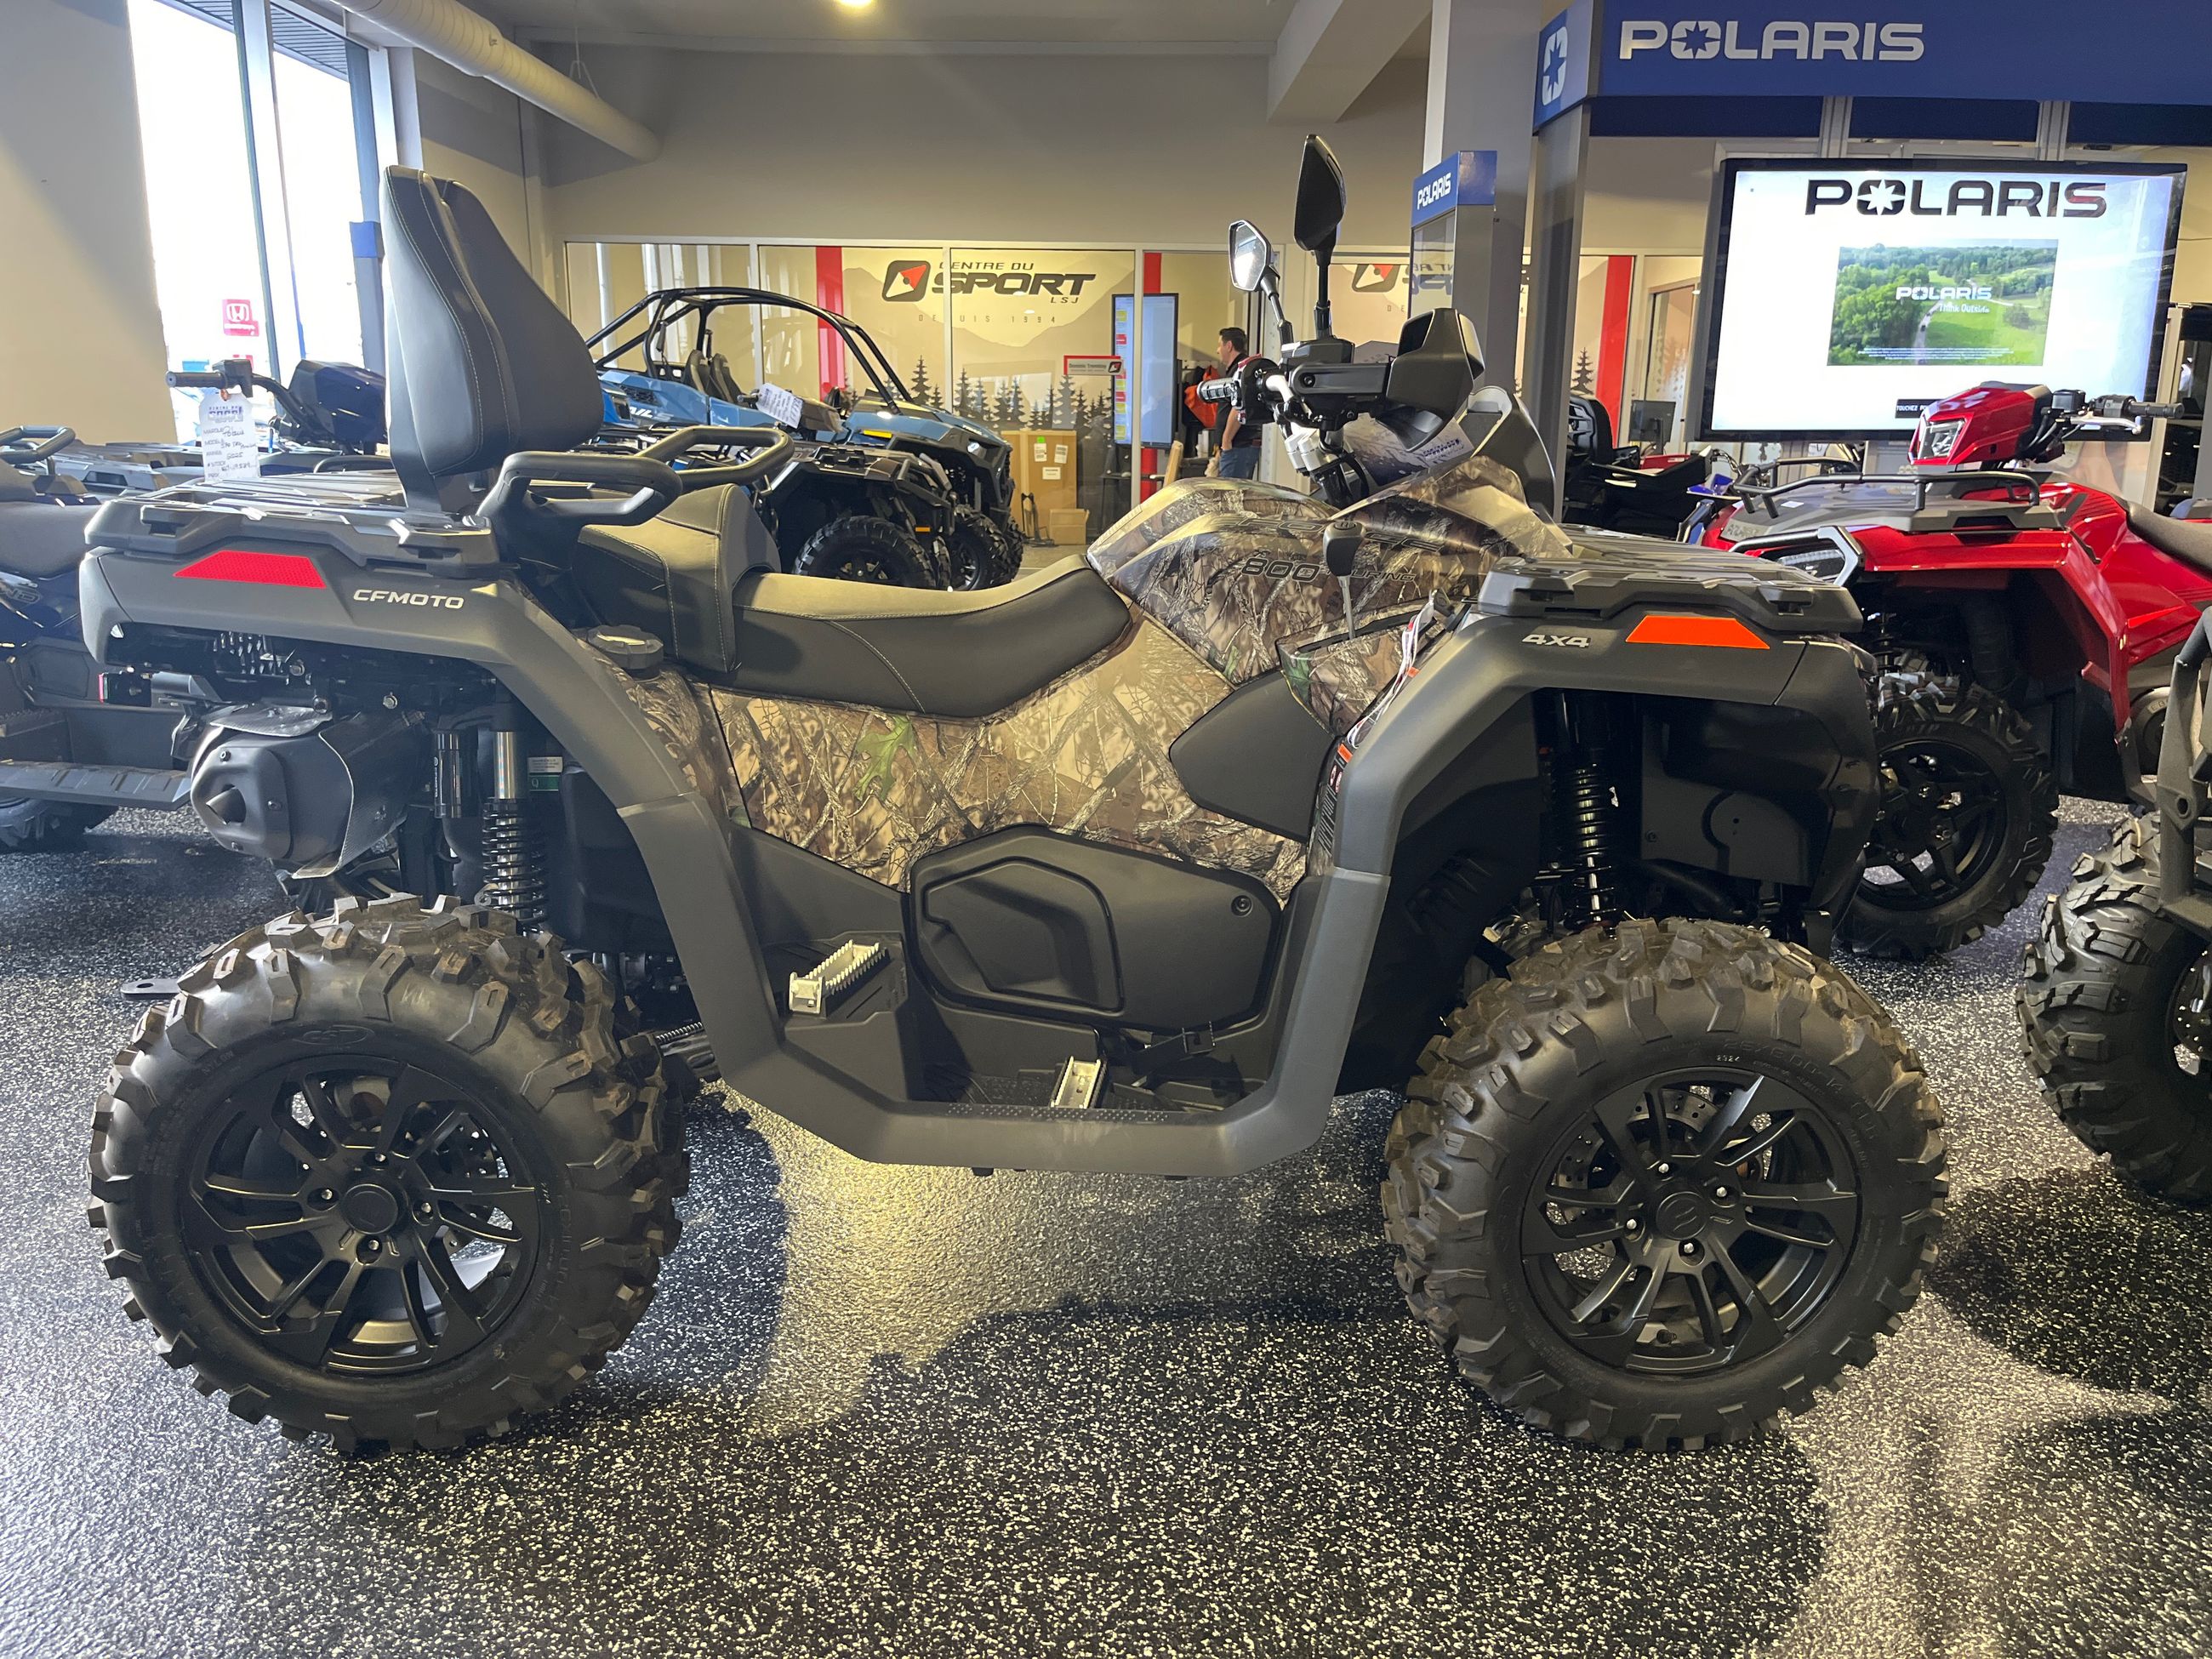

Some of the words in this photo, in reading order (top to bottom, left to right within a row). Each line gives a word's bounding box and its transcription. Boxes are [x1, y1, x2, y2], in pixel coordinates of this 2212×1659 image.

[1619, 20, 1924, 61] POLARIS
[1417, 172, 1451, 210] POLARIS
[1804, 178, 2107, 219] POLARIS
[1011, 262, 1035, 271] DU
[932, 272, 1097, 296] SPORT
[1896, 286, 1993, 300] POLARIS
[1939, 302, 1959, 312] Think
[919, 314, 990, 323] DEUIS
[1210, 516, 1445, 552] CFOCE
[1241, 557, 1320, 584] 800
[353, 589, 465, 609] CFMOTO
[1522, 634, 1590, 648] 4X4
